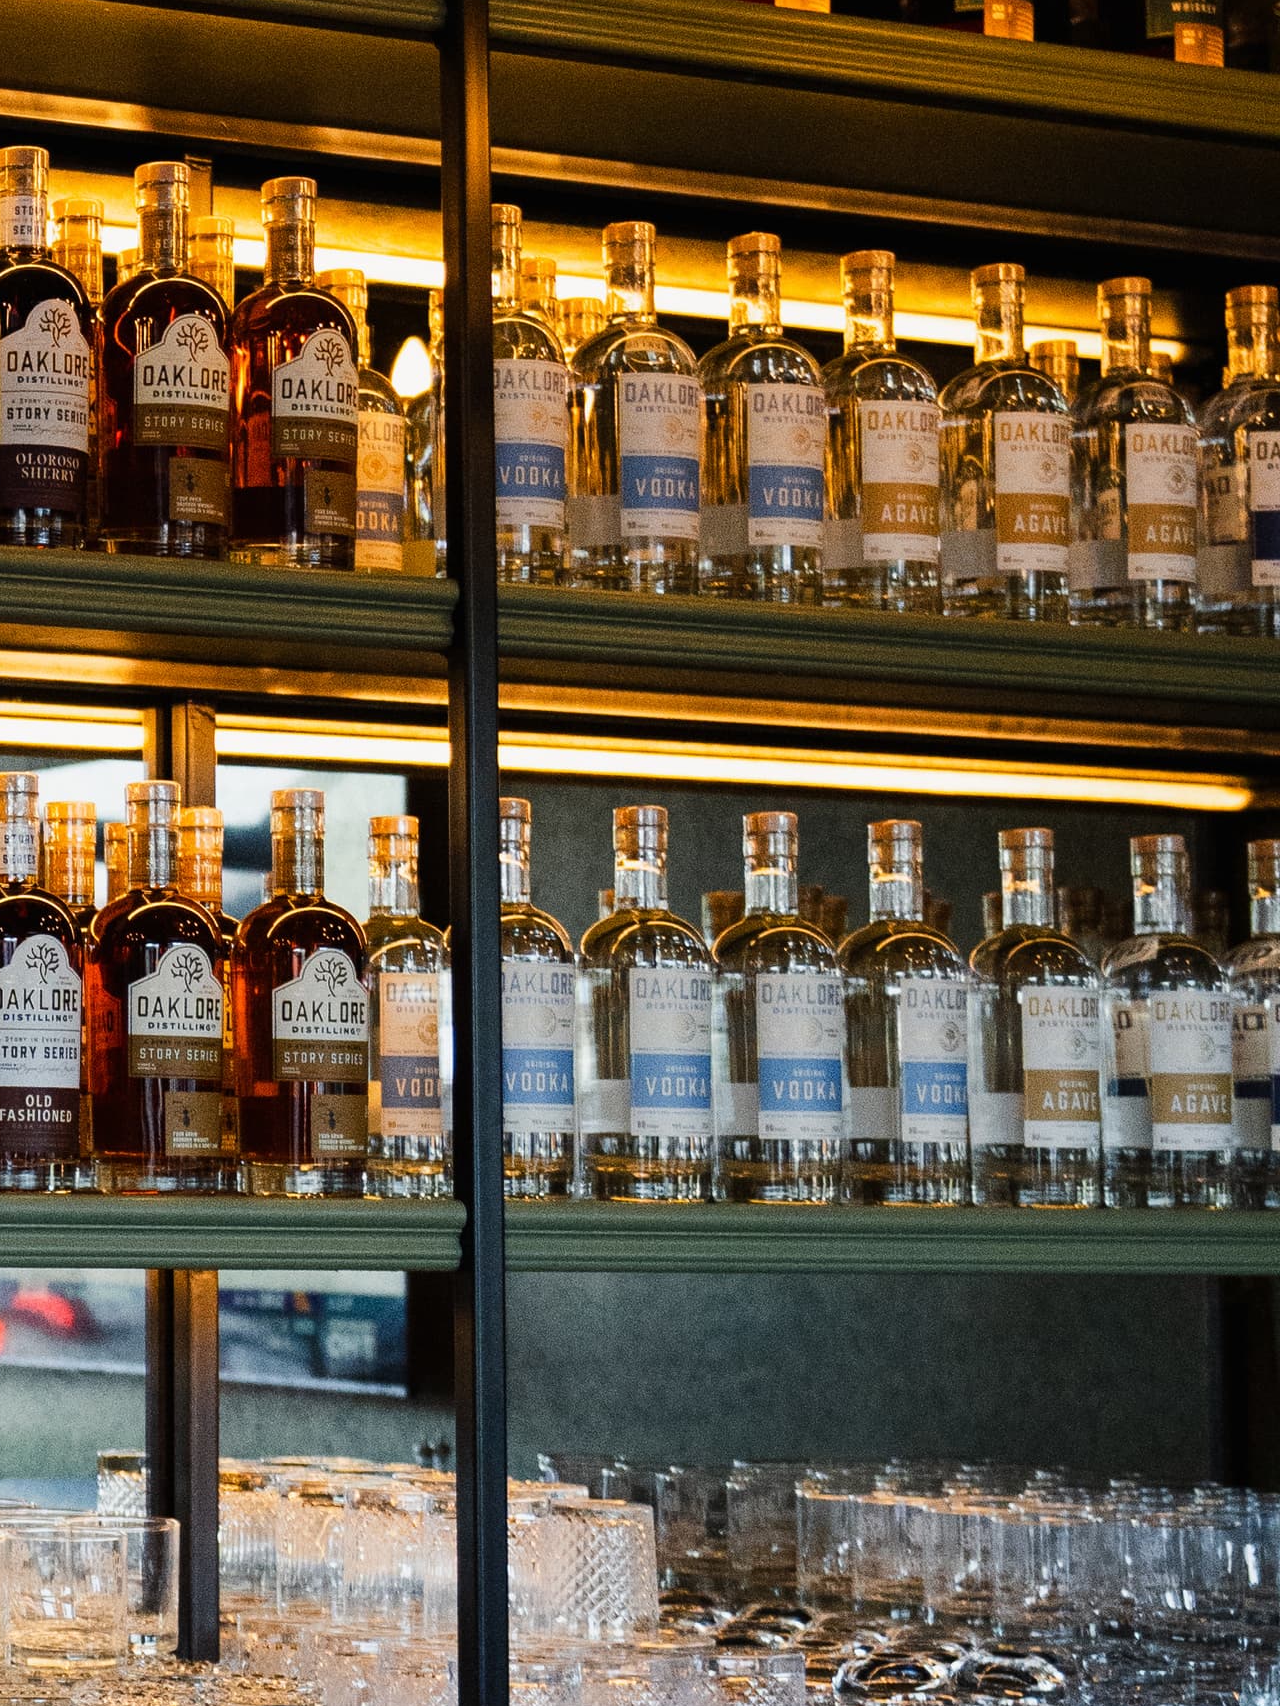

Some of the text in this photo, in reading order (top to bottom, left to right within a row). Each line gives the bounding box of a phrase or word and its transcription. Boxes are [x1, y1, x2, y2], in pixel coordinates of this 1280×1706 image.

[7, 351, 88, 377] OAKLORE
[143, 365, 228, 394] OAKLORE
[282, 378, 358, 407] OAKLORE
[6, 408, 88, 426] STORY SERIES
[144, 415, 224, 433] STORY SERIES
[15, 453, 80, 469] OLOROSO
[21, 467, 76, 482] SHERRY
[501, 466, 560, 488] VODKA
[636, 478, 696, 498] VODKA
[3, 1012, 68, 1021] DISTILLING
[137, 996, 220, 1021] OAKLORE
[282, 1000, 365, 1024] OAKLORE
[44, 1045, 78, 1060] SERIES
[140, 1048, 218, 1063] STORY SERIES
[284, 1051, 363, 1065] STORY SERIES
[506, 1073, 568, 1092] VODKA
[646, 1078, 706, 1096] VODKA
[773, 1080, 836, 1099] VODKA
[25, 1095, 52, 1108] OLD
[0, 1108, 72, 1123] FASHIONED
